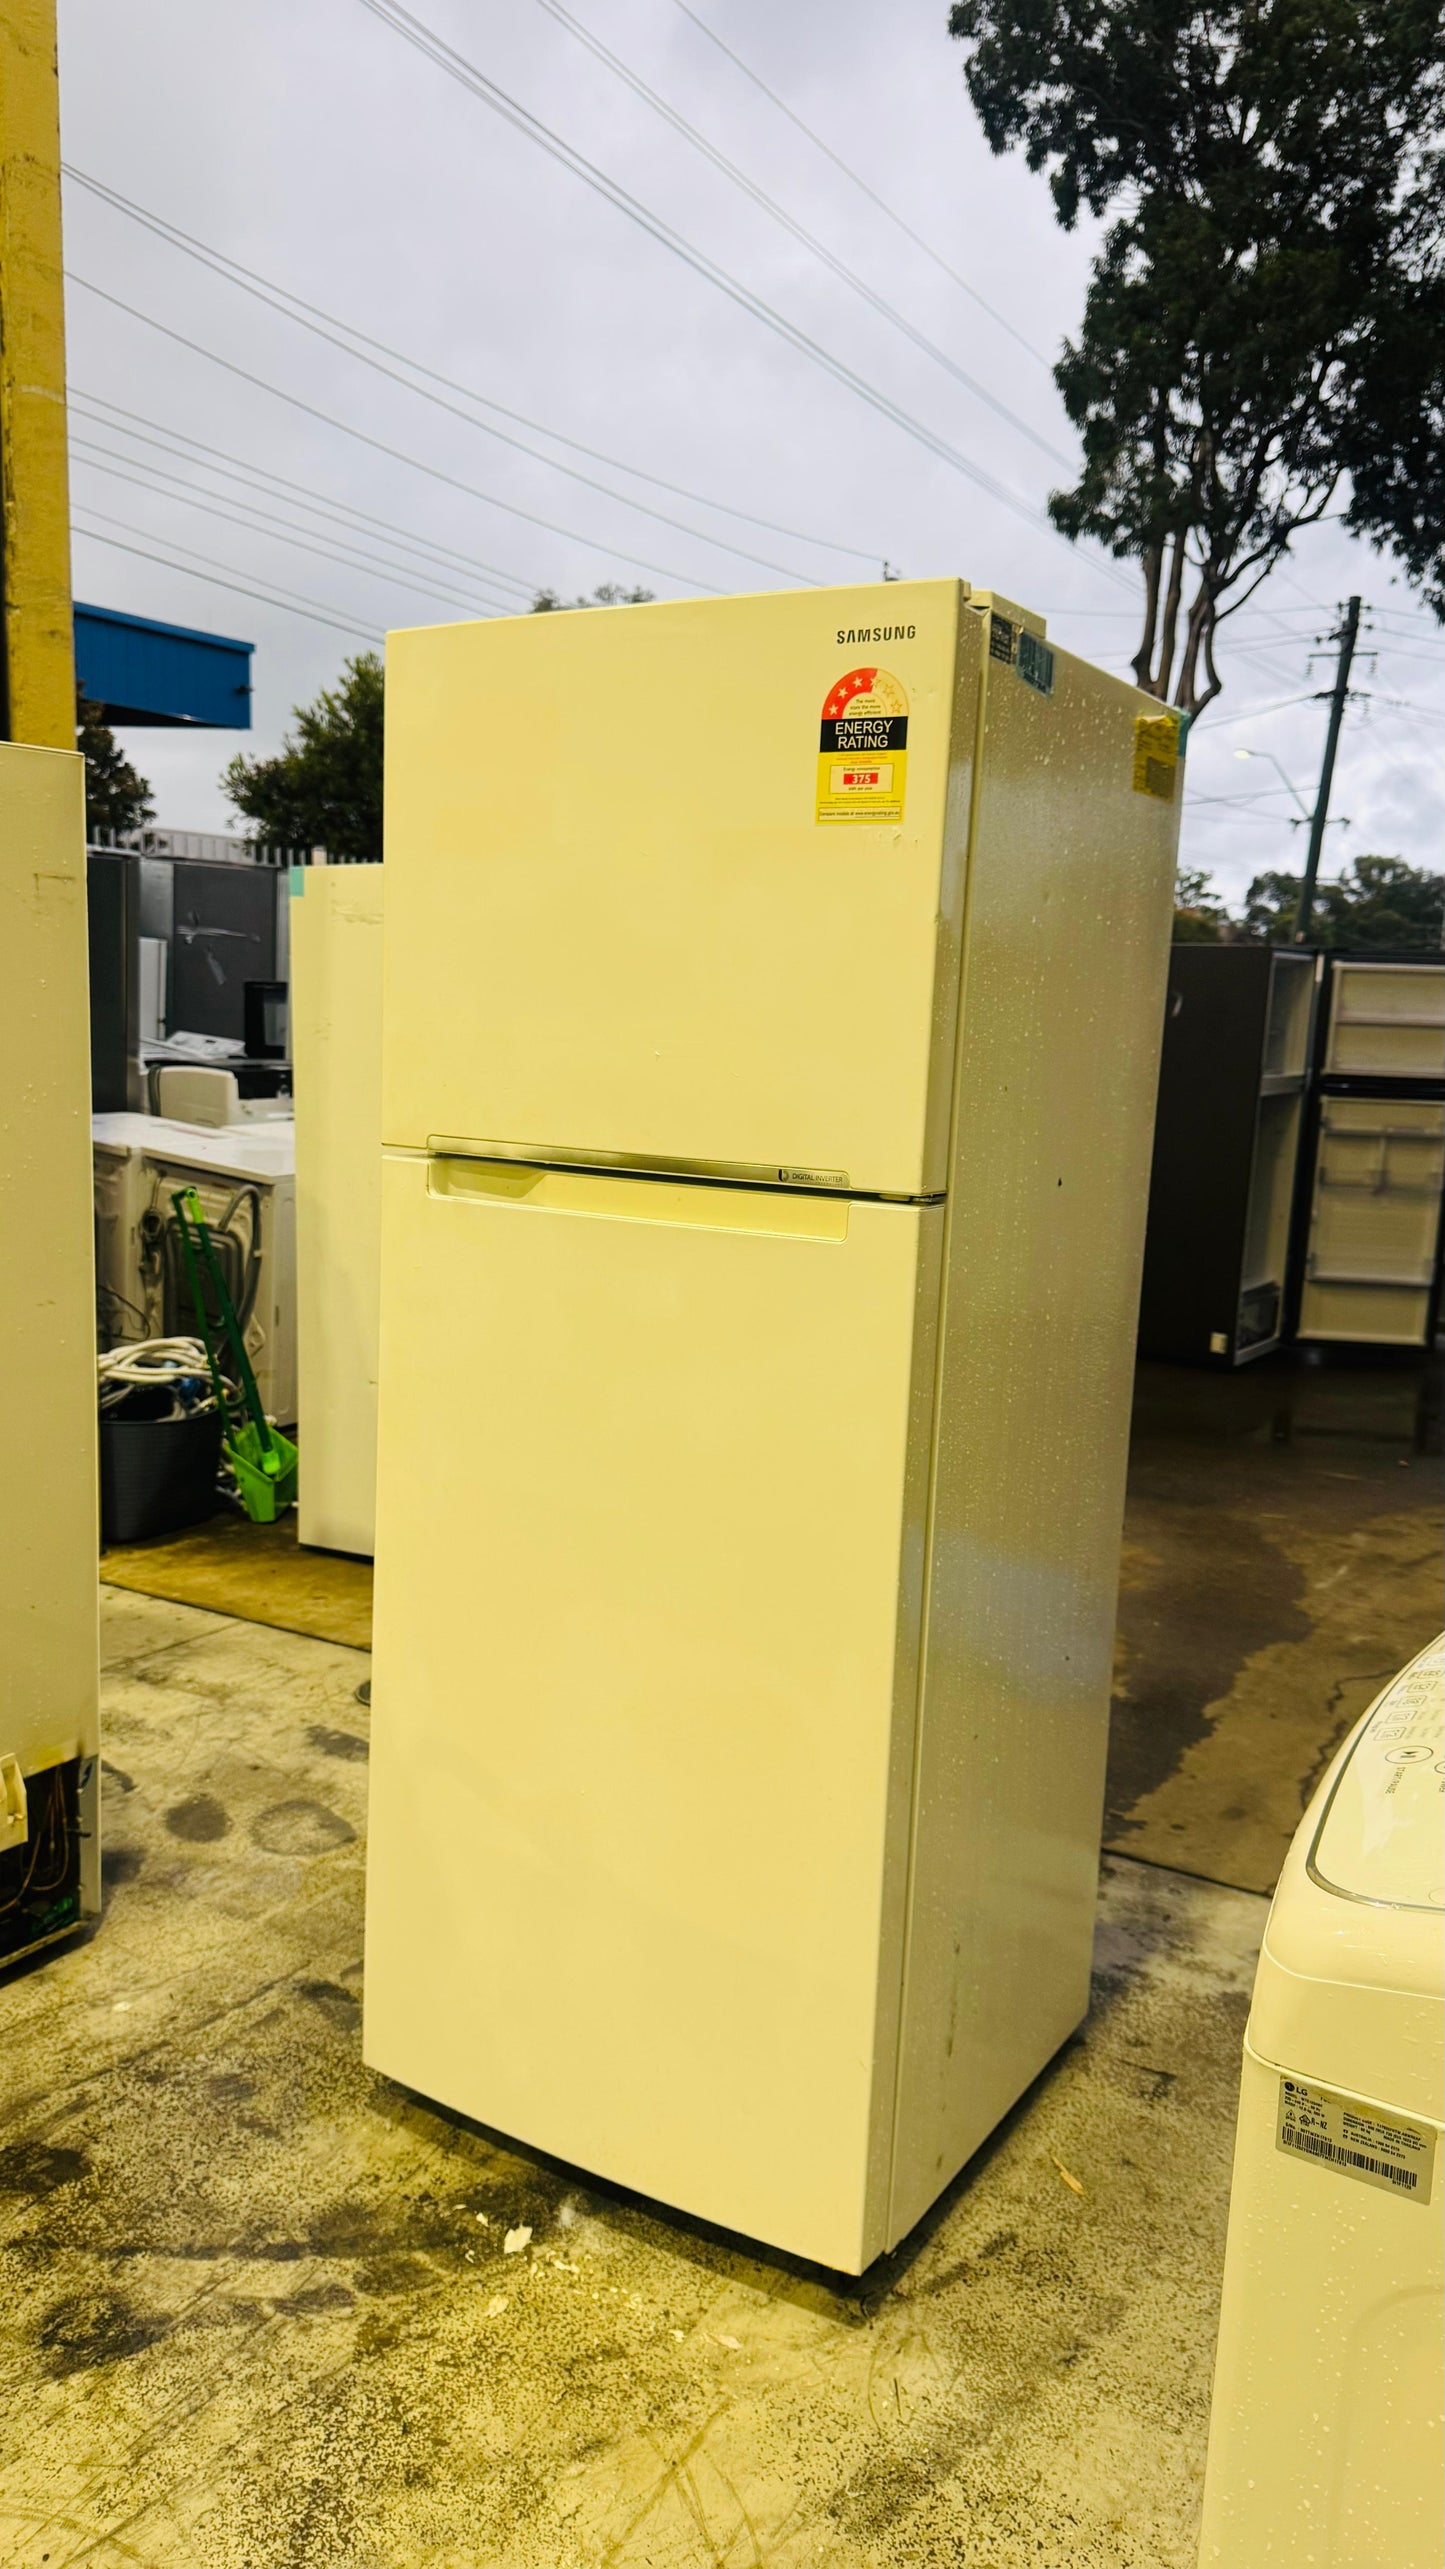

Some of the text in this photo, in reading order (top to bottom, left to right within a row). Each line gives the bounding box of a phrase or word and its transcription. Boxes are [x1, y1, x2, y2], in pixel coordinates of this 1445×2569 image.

[836, 625, 916, 645] SAMSUNG
[835, 719, 893, 736] ENERGY
[837, 735, 889, 750] RATING
[852, 774, 871, 784] 375
[792, 1172, 843, 1183] DIGITAL INVERTER
[1295, 2086, 1308, 2097] LG
